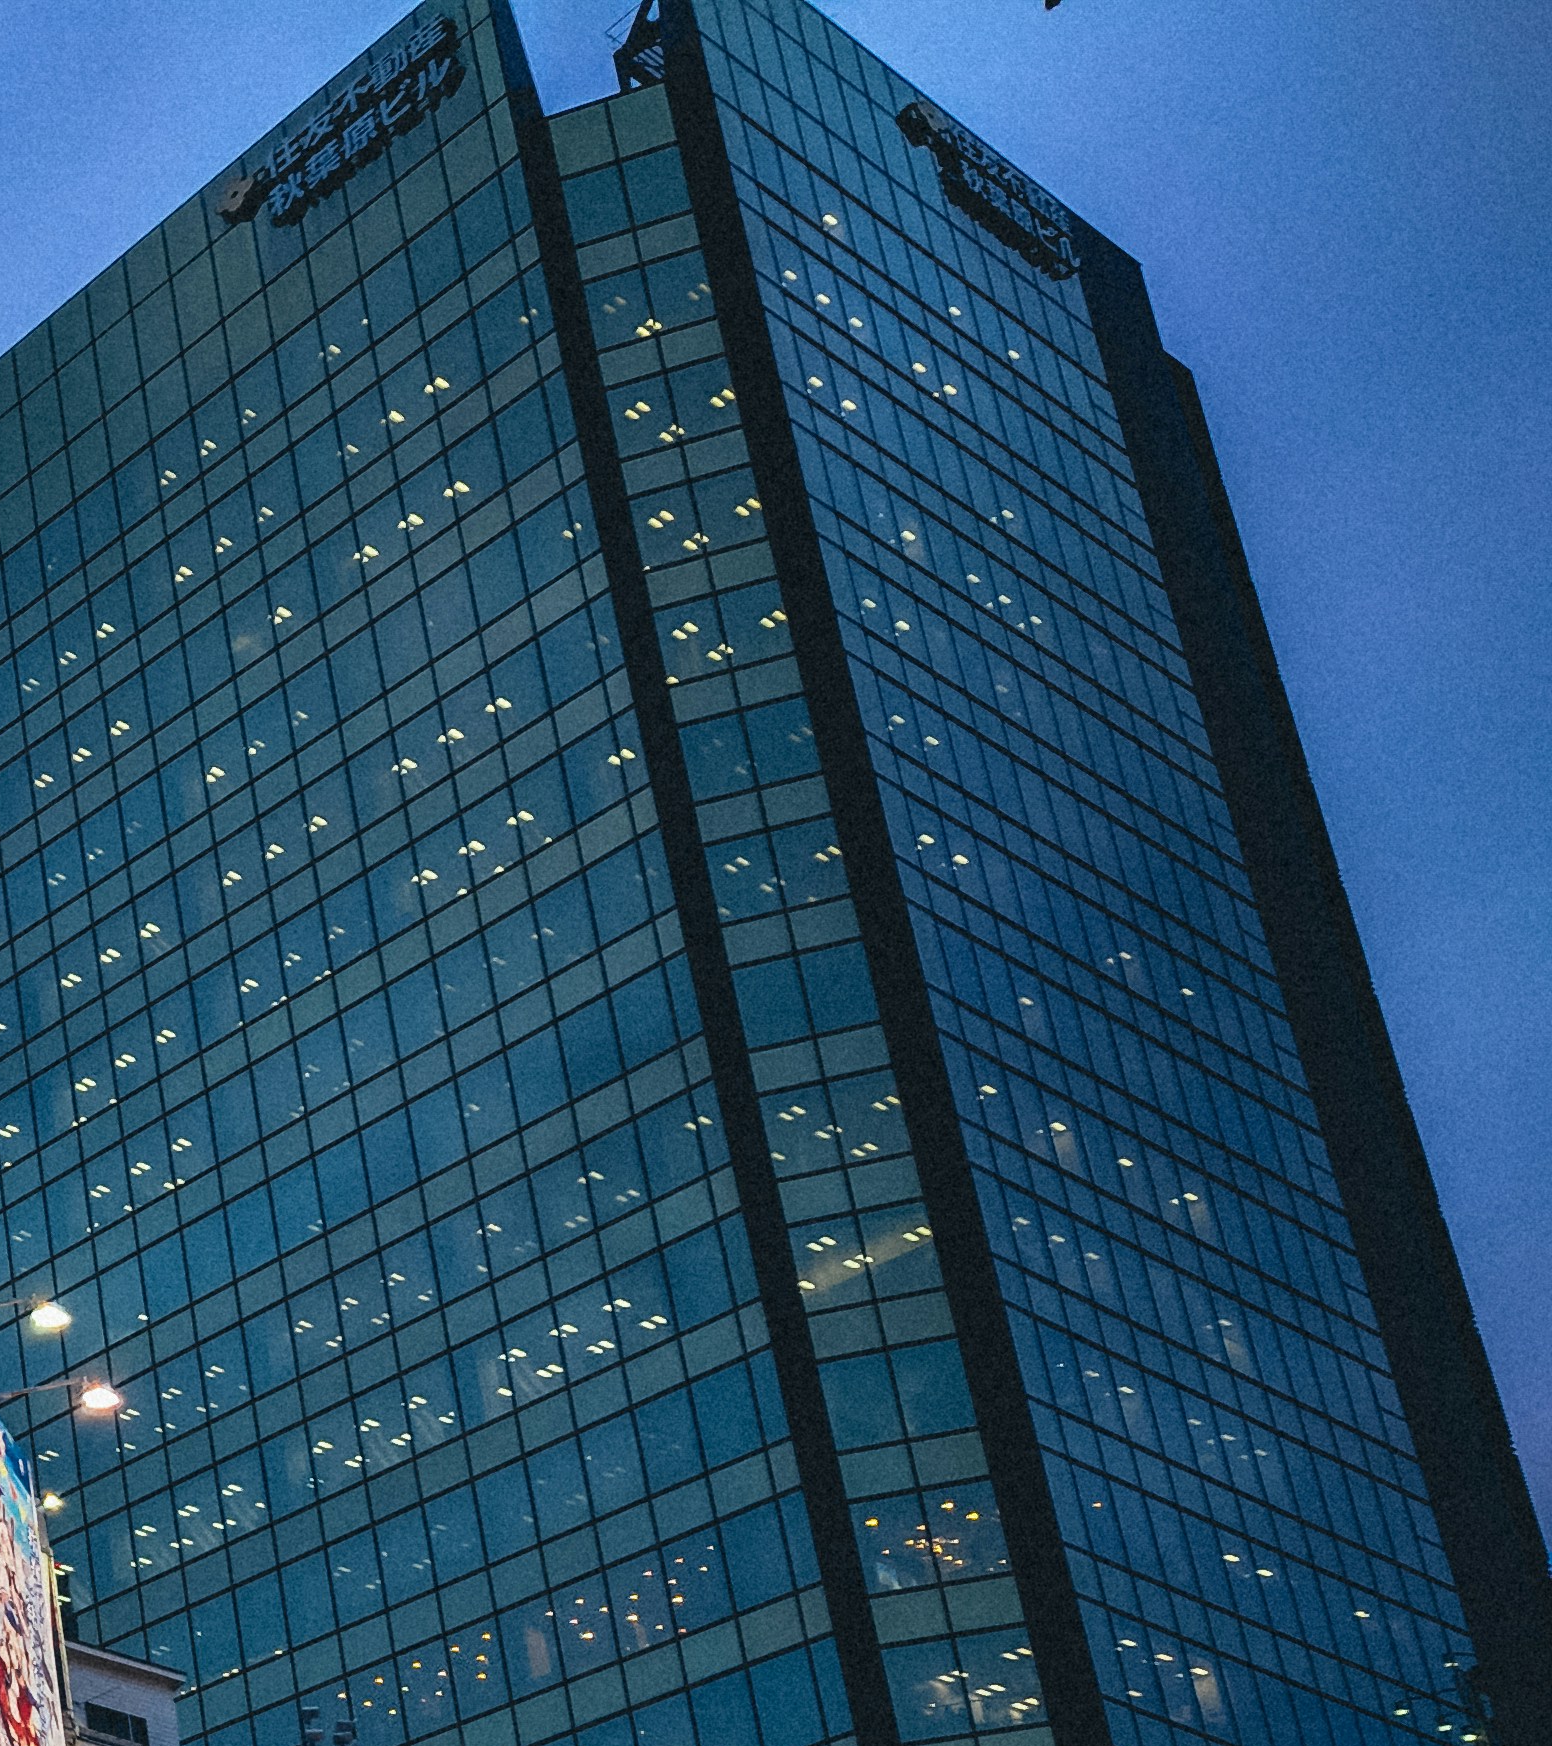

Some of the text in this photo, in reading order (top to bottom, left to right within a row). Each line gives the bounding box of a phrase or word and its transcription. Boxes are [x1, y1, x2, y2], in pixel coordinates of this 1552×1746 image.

[268, 57, 451, 216] 秋葉原ビル
